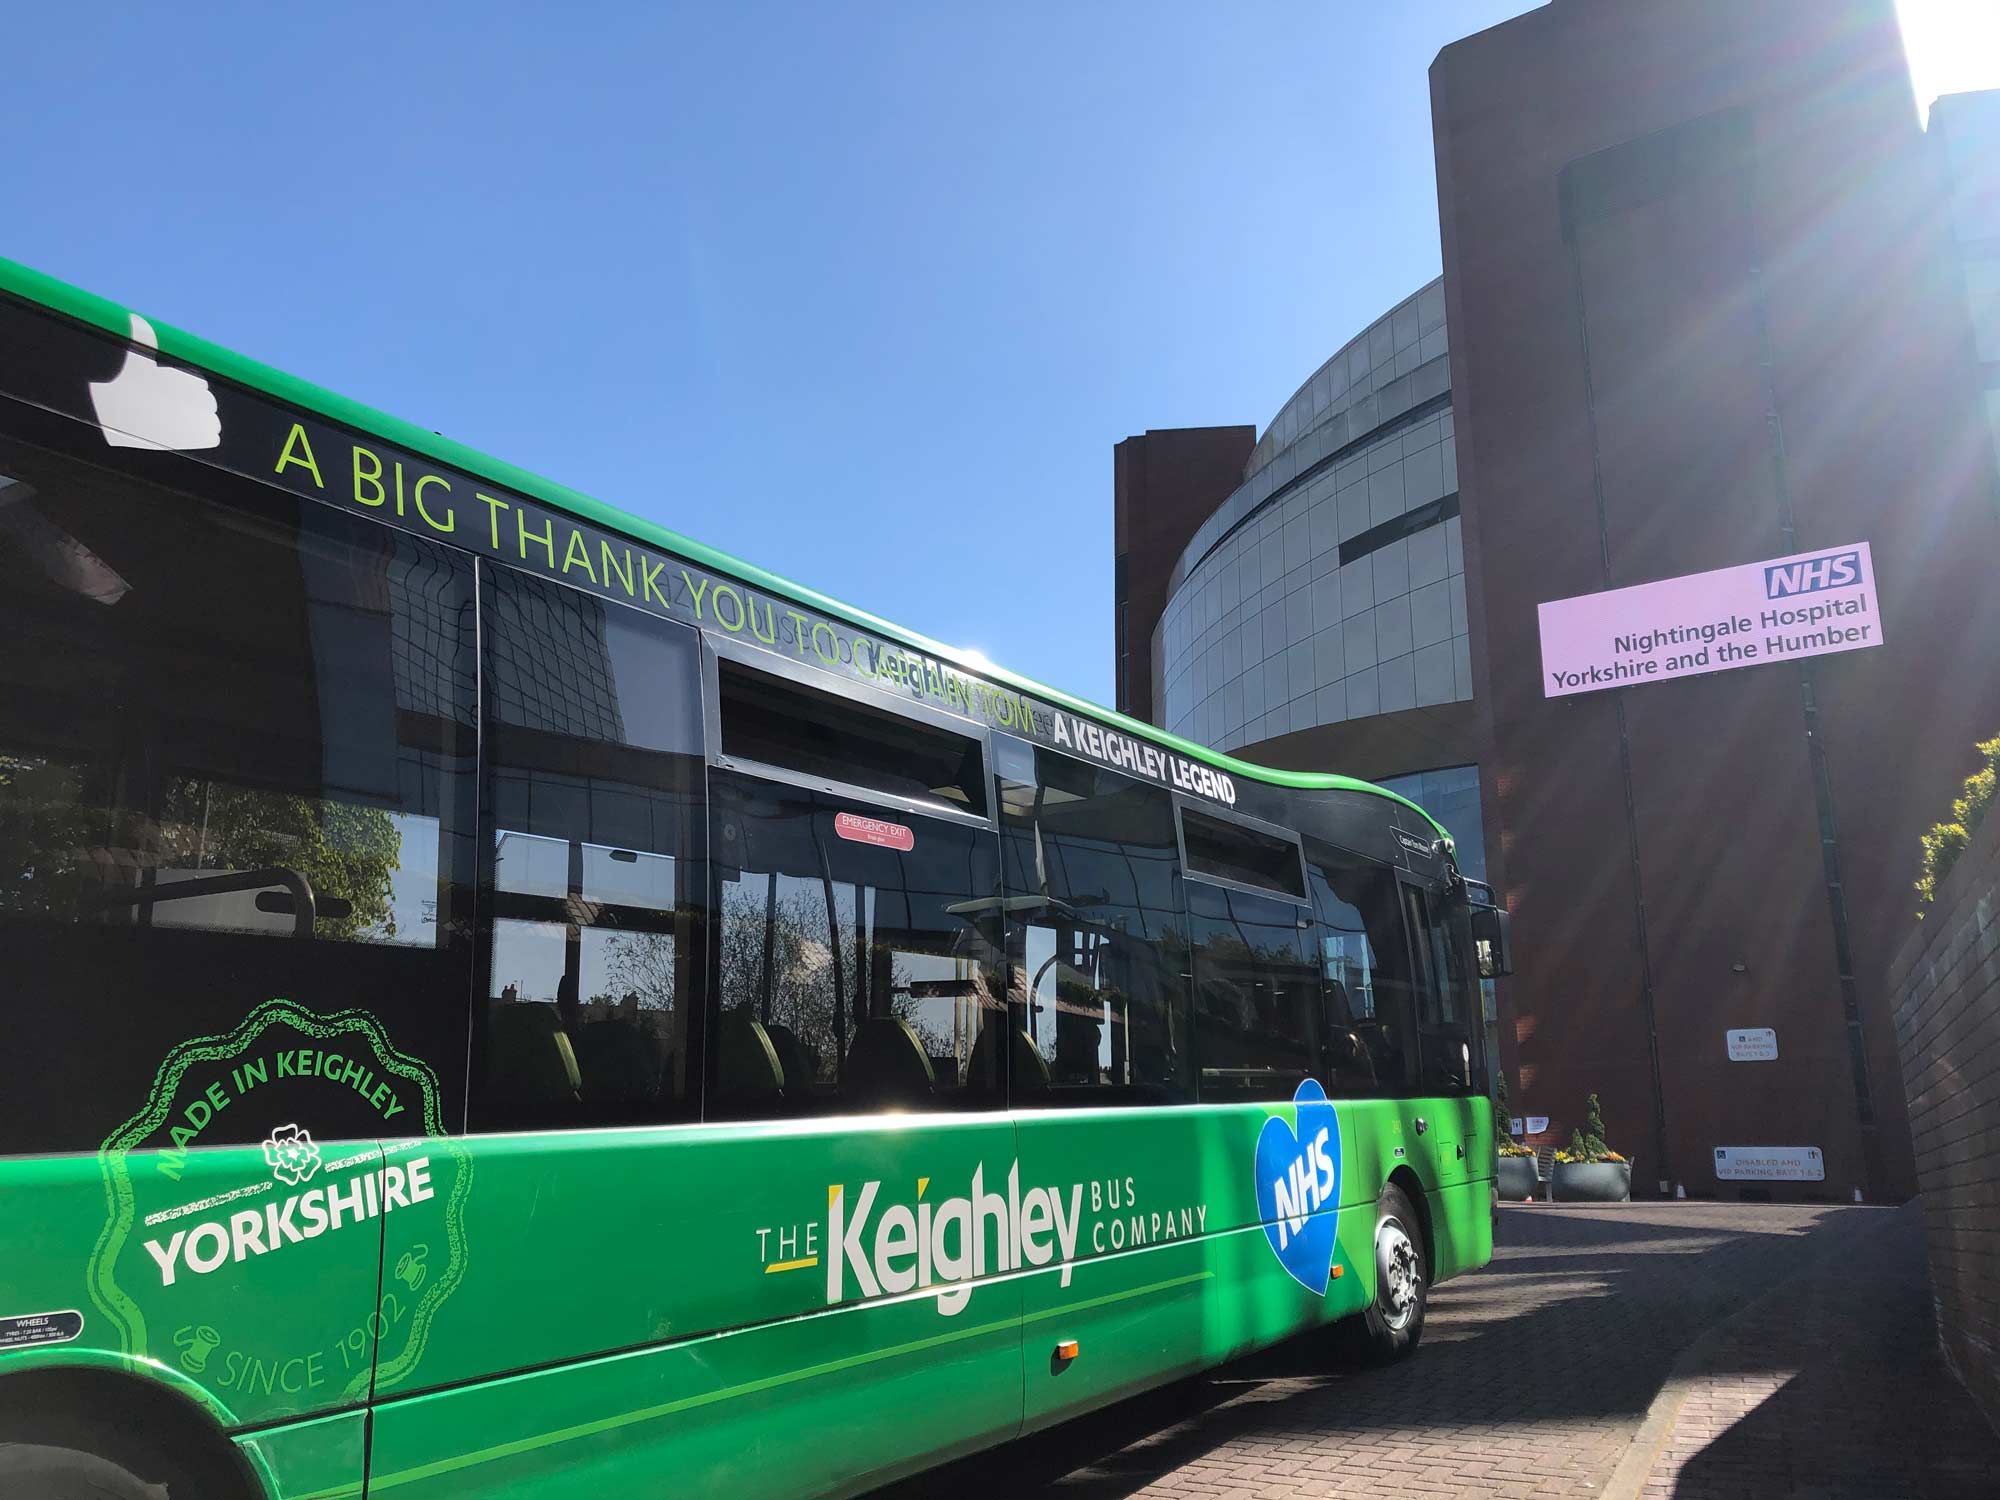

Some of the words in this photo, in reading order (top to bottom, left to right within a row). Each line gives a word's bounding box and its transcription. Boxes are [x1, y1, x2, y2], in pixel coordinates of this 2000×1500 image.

[1769, 554, 1857, 597] NHS
[275, 423, 324, 489] A
[352, 446, 455, 533] BIG
[476, 493, 670, 609] THANK
[682, 570, 775, 644] YOU
[787, 610, 840, 666] TO
[852, 637, 975, 716] CAPTAIN
[976, 683, 1037, 736] TOM
[1054, 712, 1073, 748] A
[1072, 719, 1167, 781] KEIGHLEY
[1169, 755, 1236, 805] LEGEND
[1614, 615, 1753, 654] Nightingale
[1761, 593, 1867, 630] Hospital
[1552, 657, 1659, 690] Yorkshire
[1665, 647, 1710, 672] and
[1716, 641, 1758, 664] the
[1766, 622, 1871, 656] Humber
[842, 815, 889, 834] EMERGENCY
[890, 826, 907, 838] EXIT
[156, 1081, 231, 1182] MADE
[232, 1057, 268, 1095] IN
[276, 1050, 405, 1120] KEIGHLEY
[143, 1156, 435, 1287] YORKSHIRE
[1091, 1177, 1136, 1213] BUS
[1274, 1127, 1335, 1251] NHS
[756, 1222, 818, 1263] THE
[827, 1156, 1083, 1317] Keighley
[1093, 1205, 1207, 1253] COMPANY
[16, 1317, 49, 1328] WHEELS
[217, 1351, 325, 1396] SINCE
[335, 1293, 406, 1369] 1902
